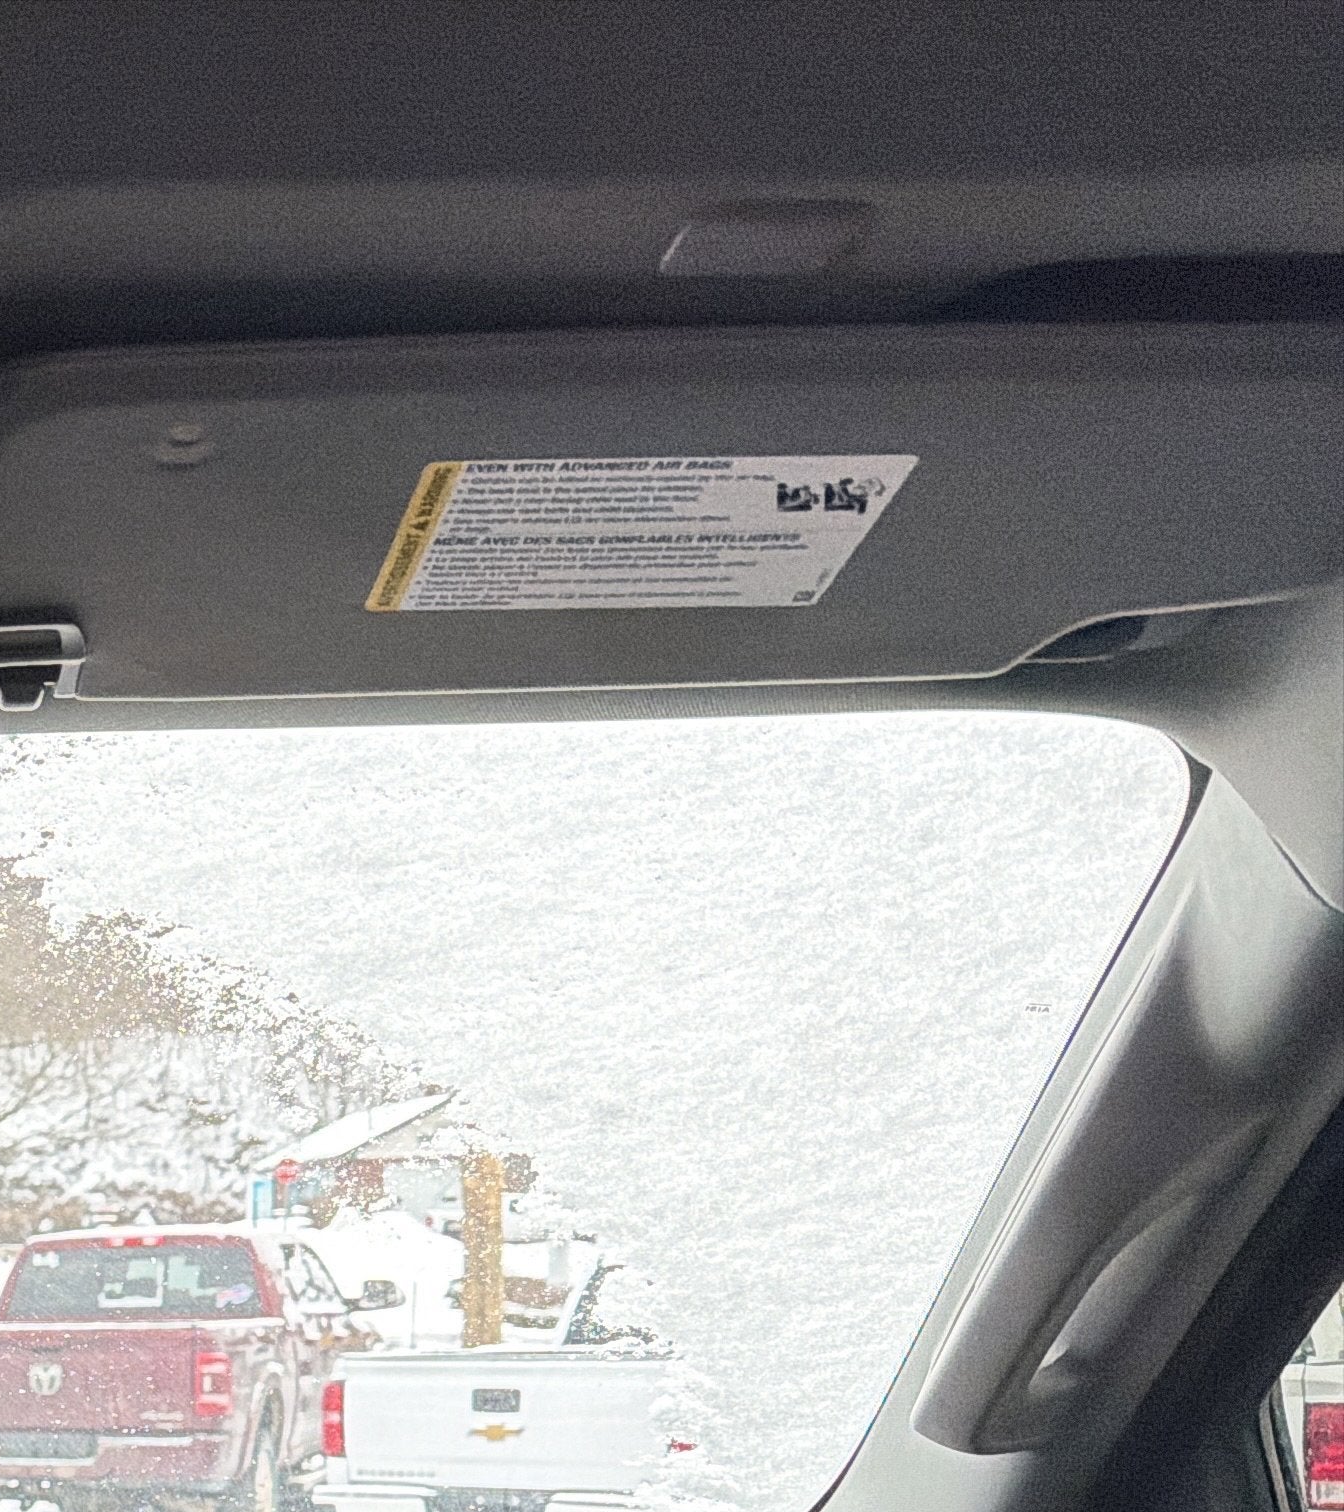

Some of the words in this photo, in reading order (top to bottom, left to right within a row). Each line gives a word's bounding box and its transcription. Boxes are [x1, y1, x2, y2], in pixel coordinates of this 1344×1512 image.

[466, 464, 508, 473] EVEN
[513, 463, 555, 472] WITH
[561, 462, 650, 471] ADVANCED
[654, 461, 681, 470] AIR
[685, 461, 732, 470] BAGS
[481, 536, 521, 546] AVEC
[523, 536, 553, 545] DES
[565, 536, 596, 545] SACS
